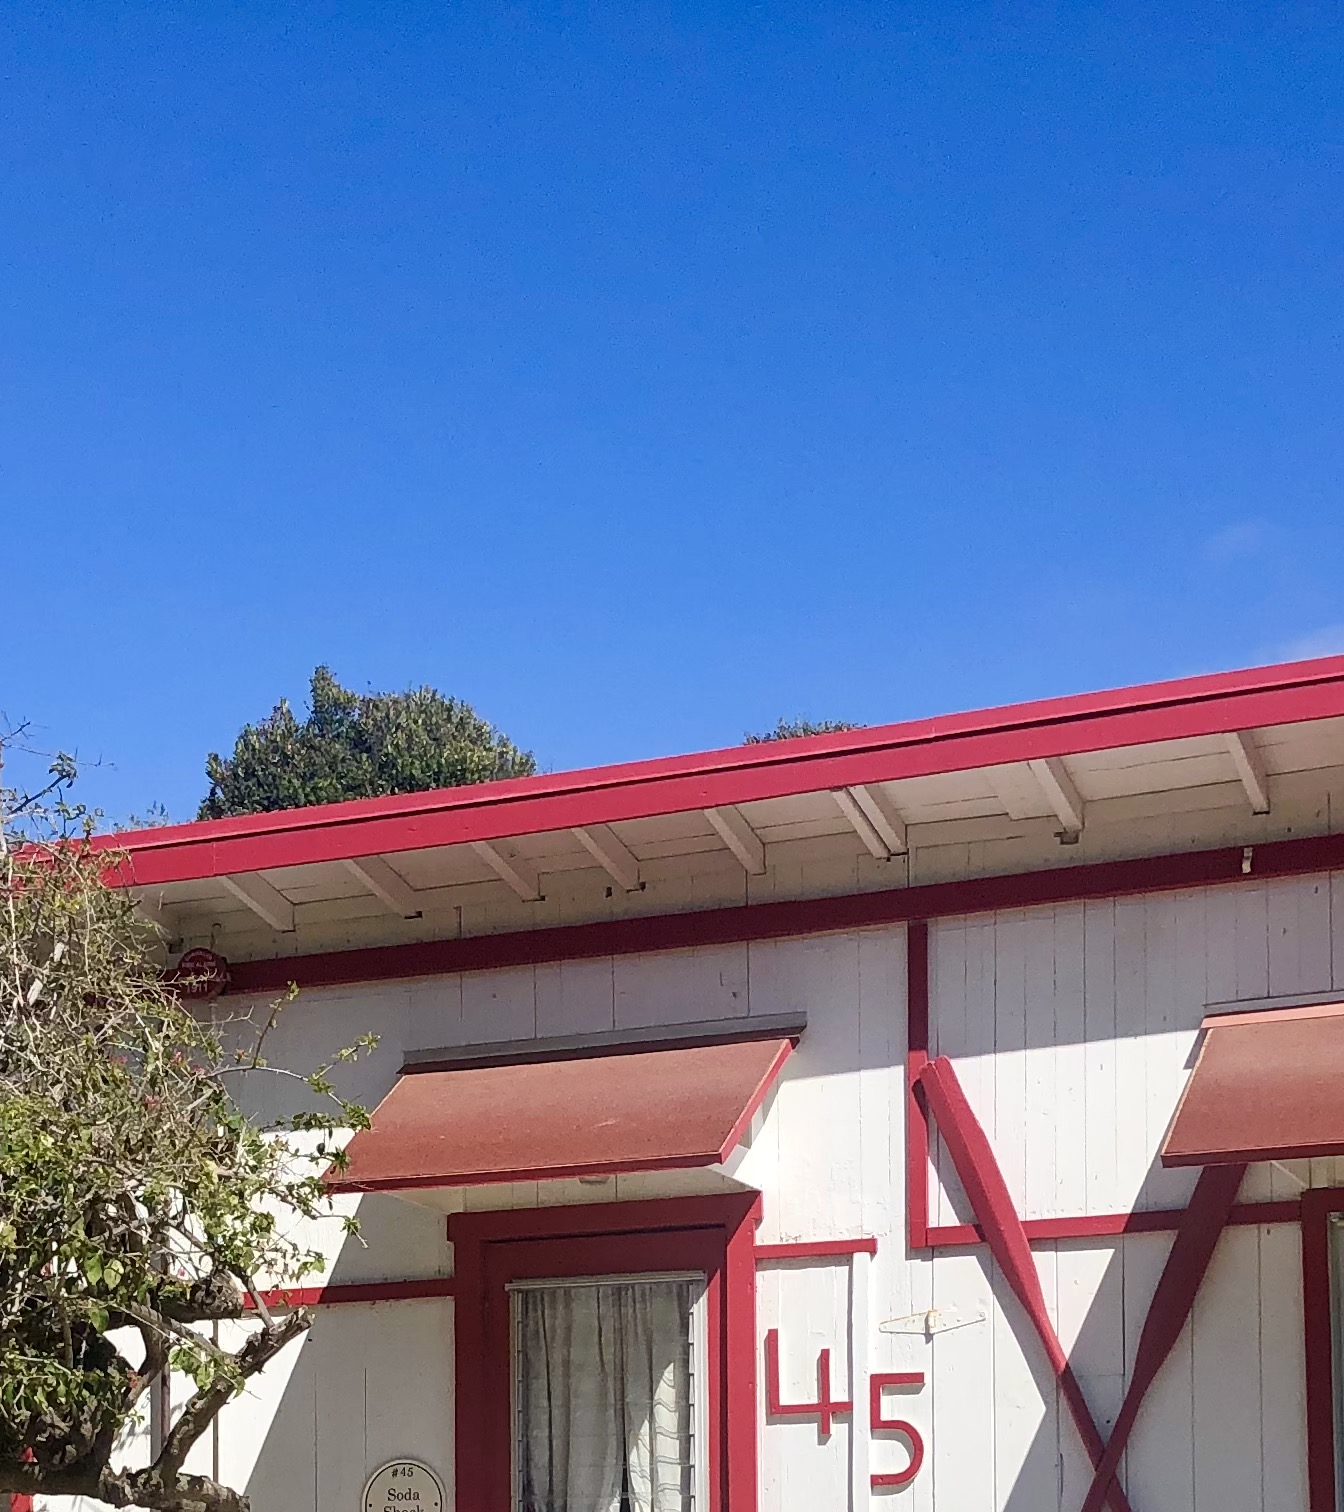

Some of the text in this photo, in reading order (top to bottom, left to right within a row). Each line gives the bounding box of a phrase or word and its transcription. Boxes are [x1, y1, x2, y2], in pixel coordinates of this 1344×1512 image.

[768, 1328, 925, 1487] 45
[391, 1467, 414, 1478] #45
[387, 1488, 420, 1501] Soda
